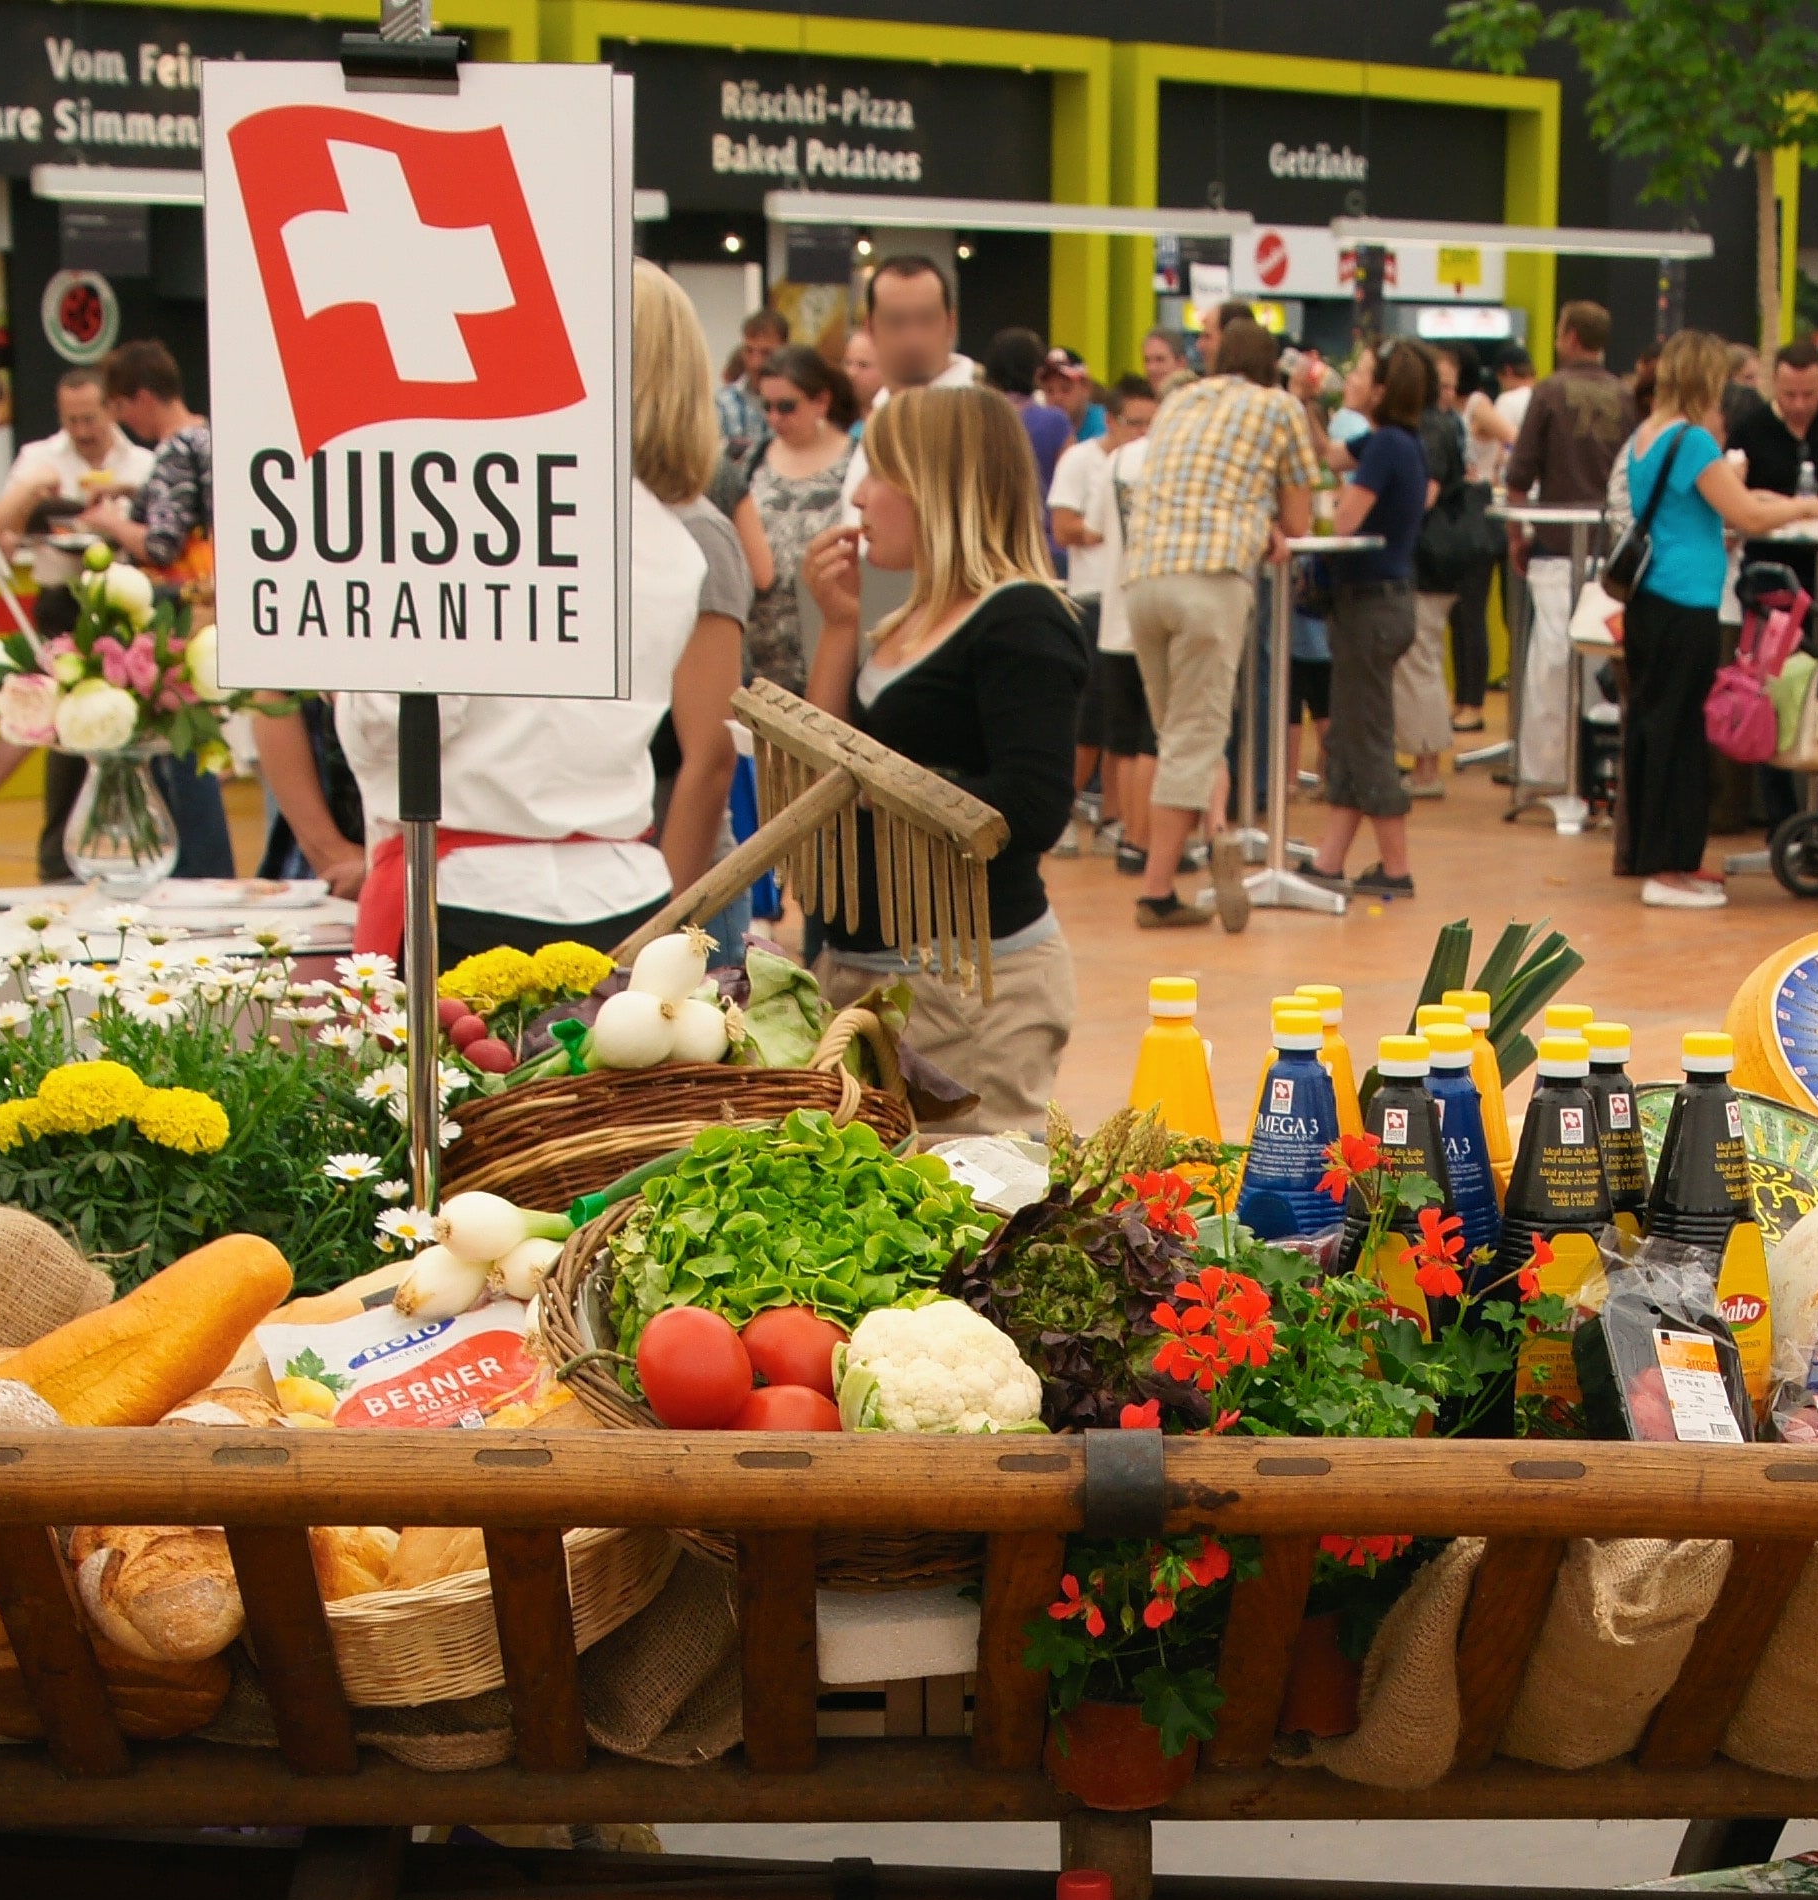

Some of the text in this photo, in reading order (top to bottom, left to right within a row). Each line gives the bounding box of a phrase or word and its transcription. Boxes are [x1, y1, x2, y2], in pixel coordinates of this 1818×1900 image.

[45, 36, 129, 86] Vom
[54, 97, 201, 149] Simmen
[721, 79, 915, 129] Röschti-Pizza
[712, 132, 922, 182] Baked Potatoes
[1269, 142, 1369, 180] Getränke
[249, 448, 578, 568] SUISSE
[253, 578, 578, 643] GARANTIE
[1257, 1113, 1320, 1135] MEGA 3
[364, 1356, 504, 1418] BERNER
